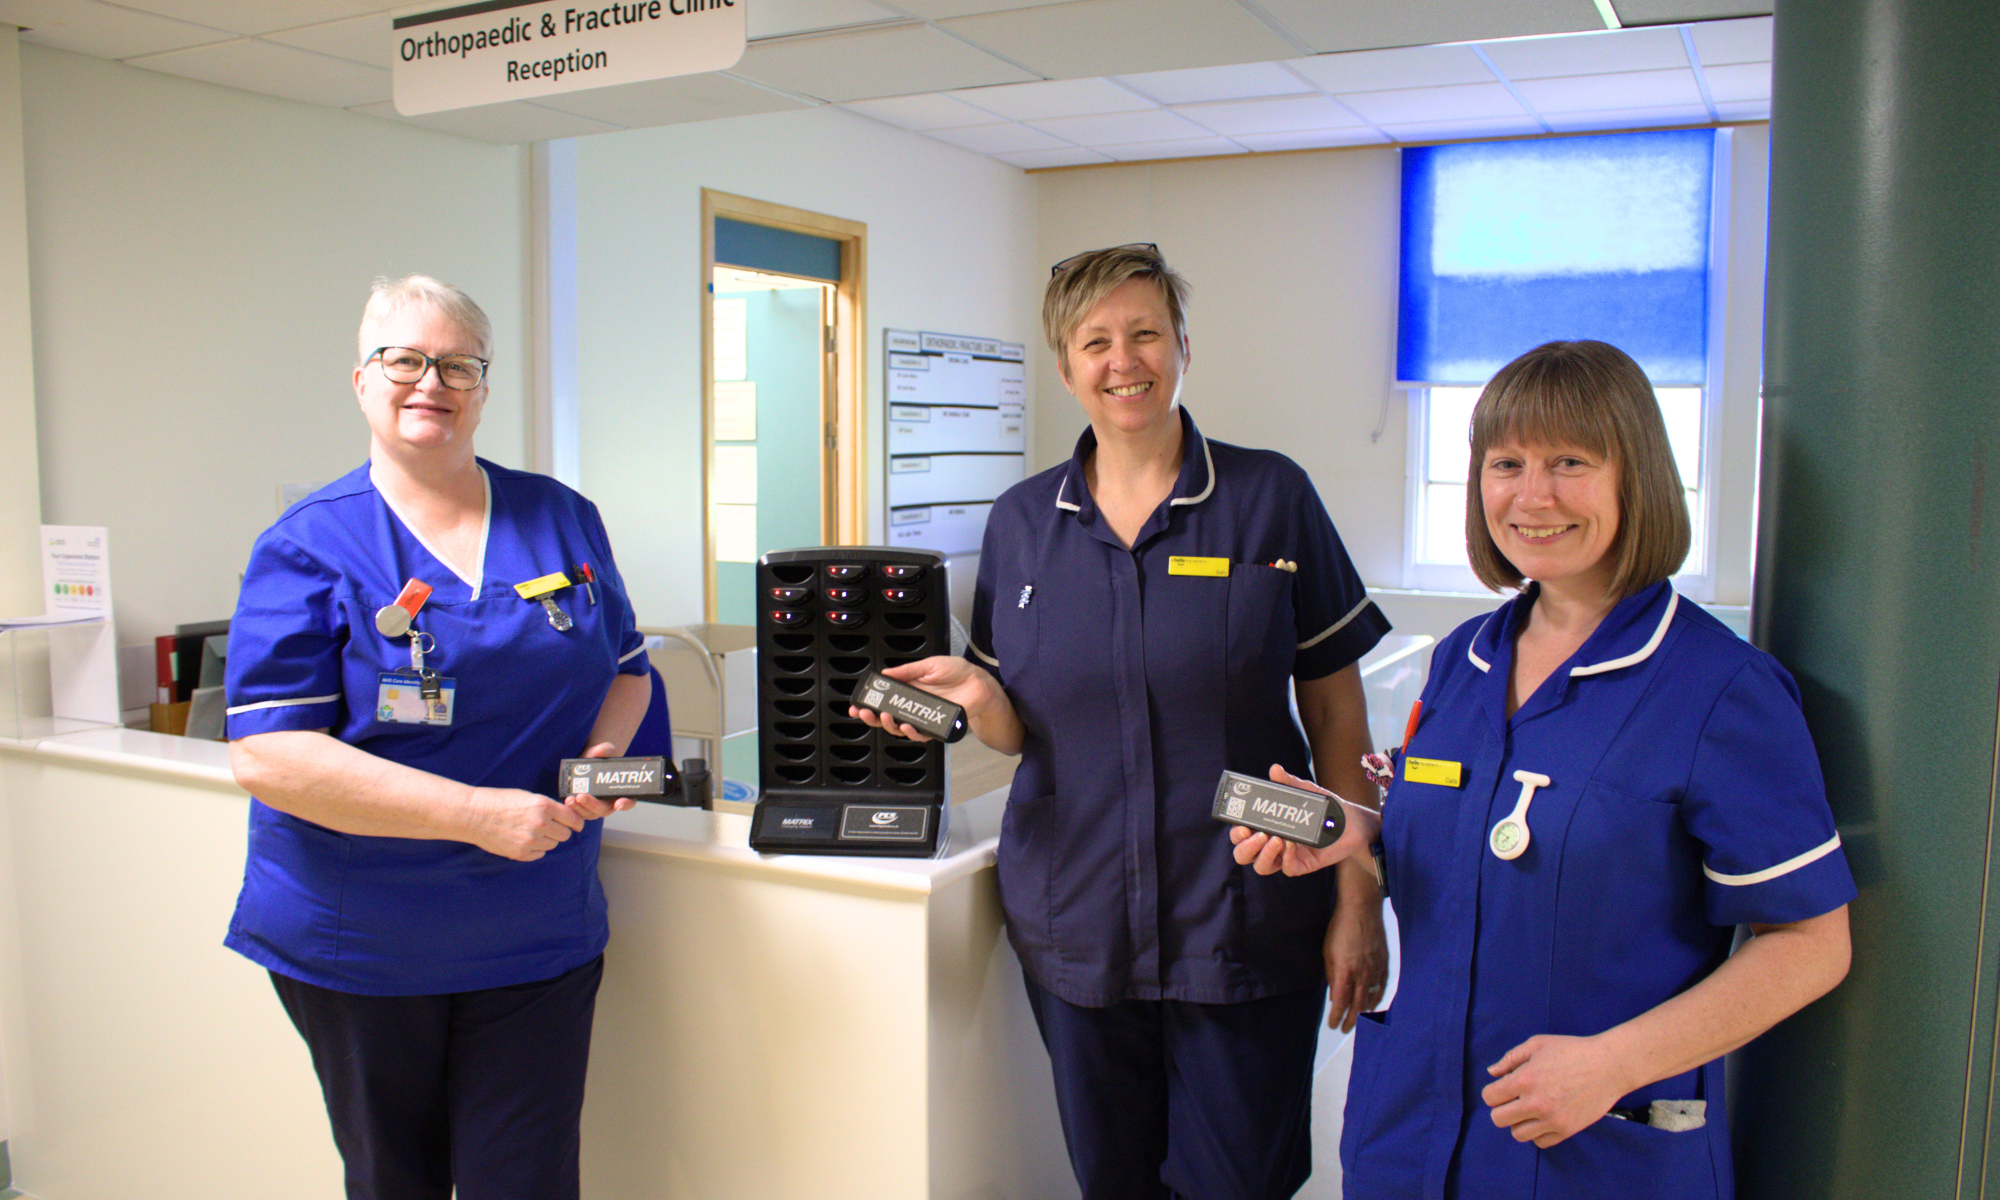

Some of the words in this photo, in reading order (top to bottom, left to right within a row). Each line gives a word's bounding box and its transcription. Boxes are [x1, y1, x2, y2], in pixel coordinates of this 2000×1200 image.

[400, 16, 532, 62] Orthopaedic
[540, 12, 556, 37] &
[565, 0, 661, 34] Fracture
[507, 49, 608, 82] Reception
[889, 694, 946, 724] MATRIX
[596, 764, 655, 784] MATRIX
[1252, 797, 1314, 826] MATRIX
